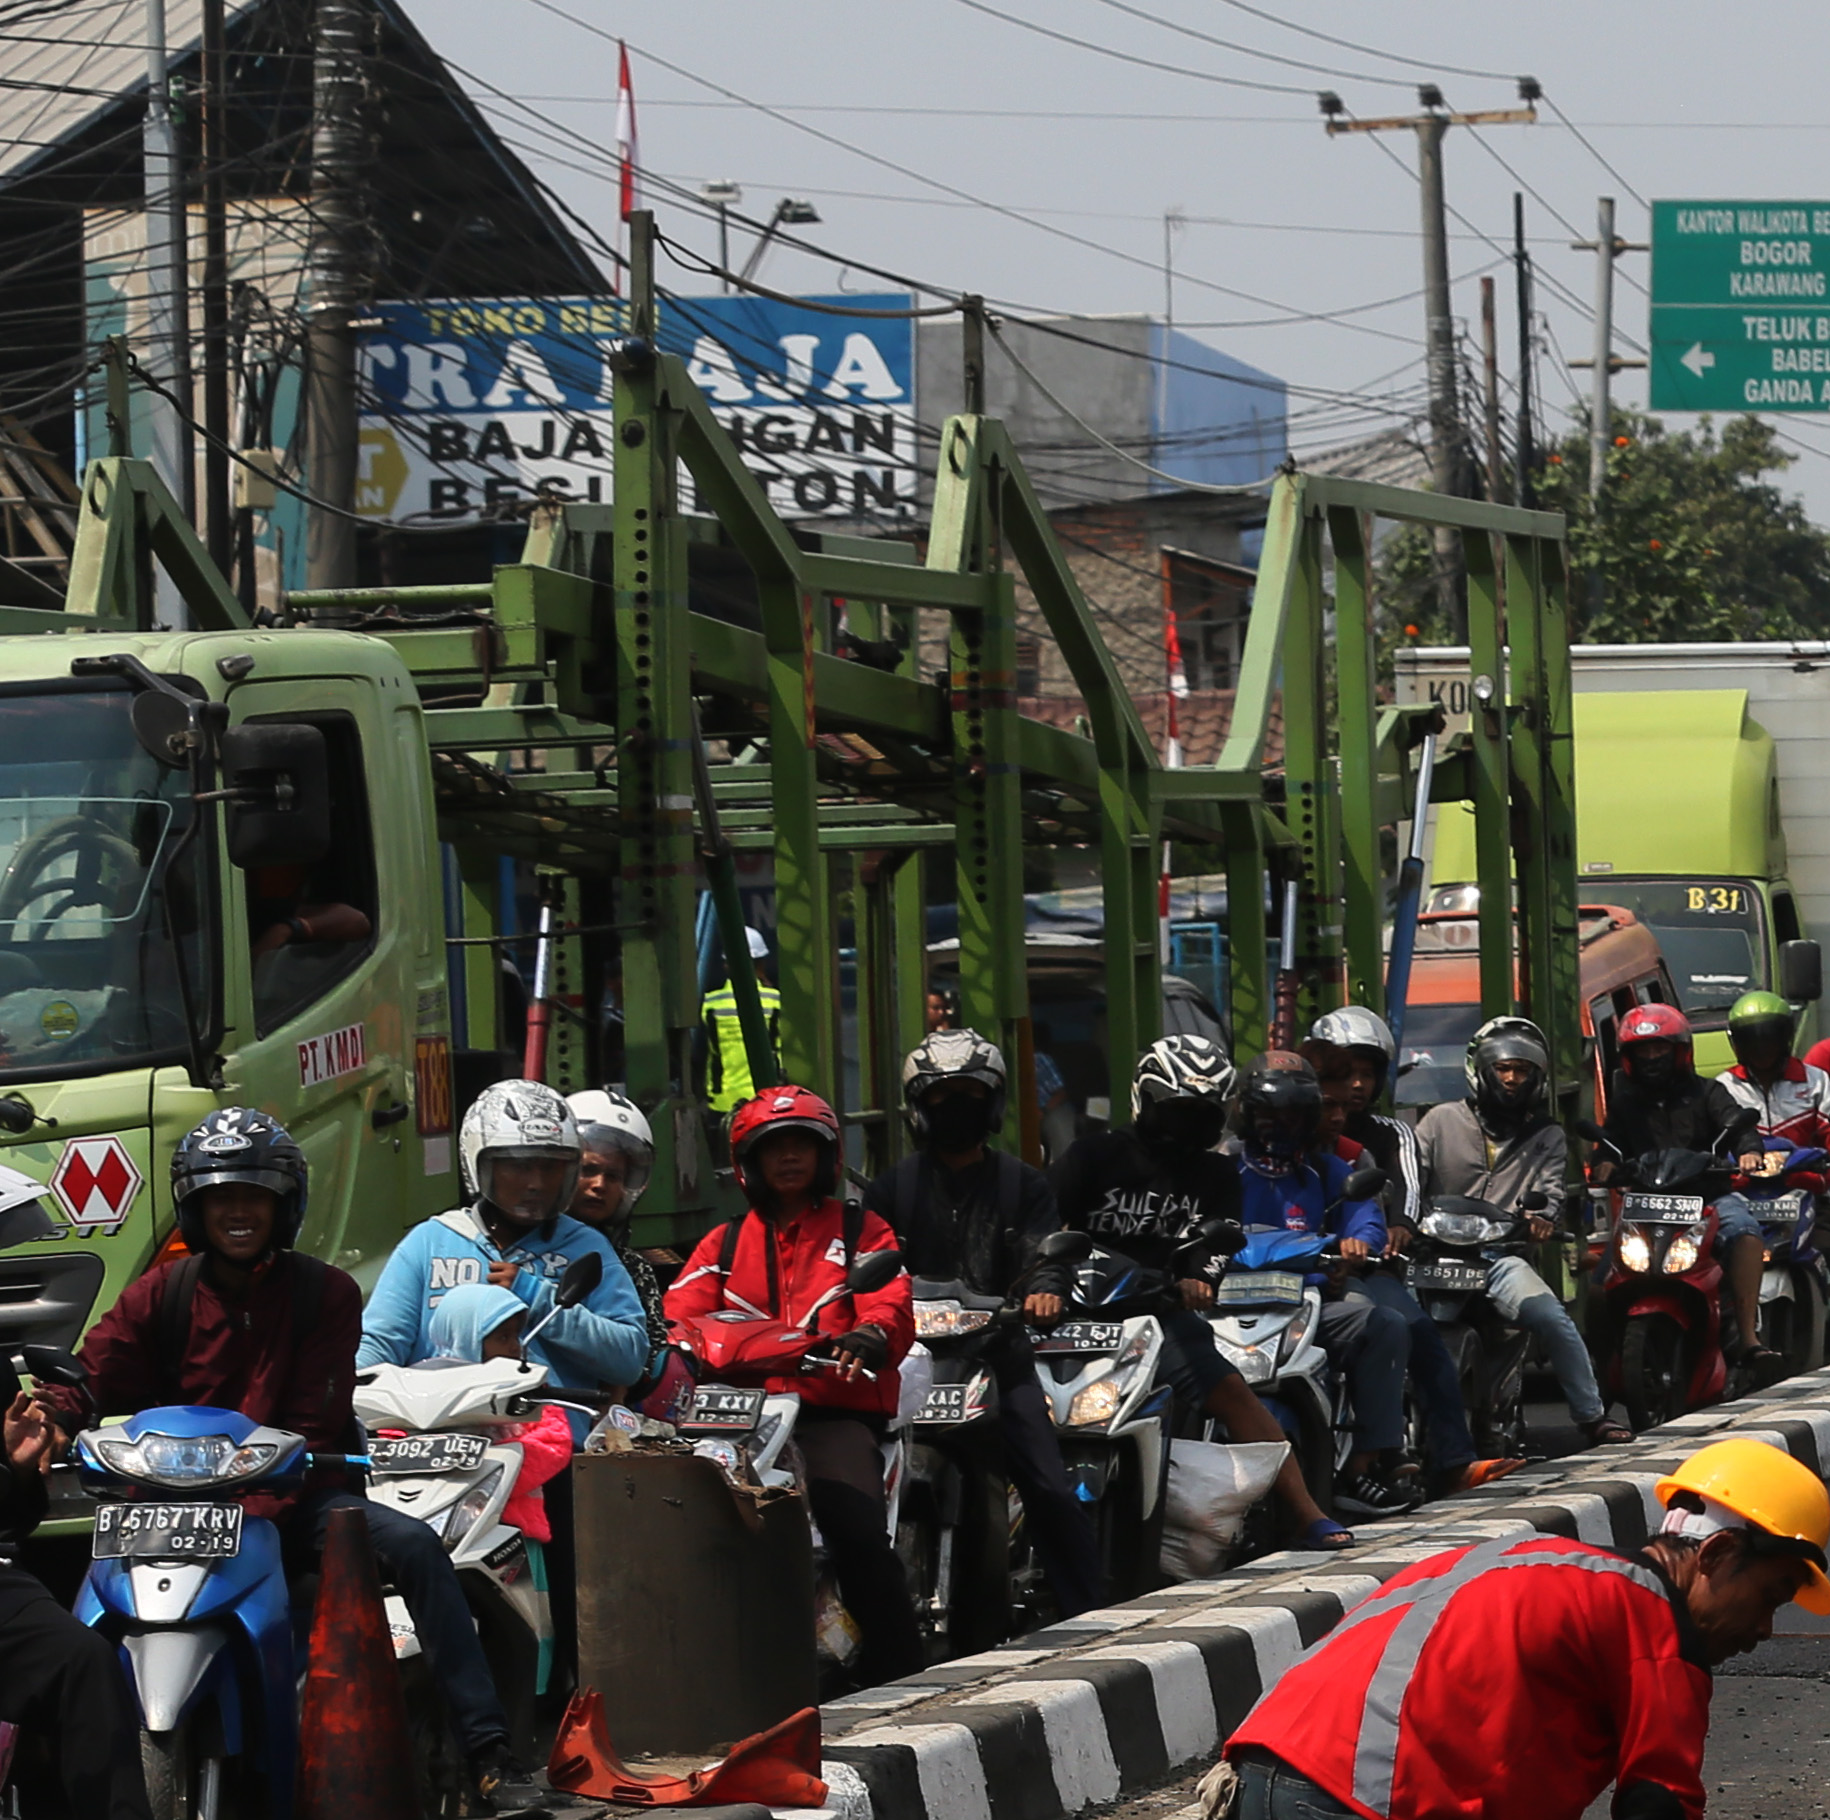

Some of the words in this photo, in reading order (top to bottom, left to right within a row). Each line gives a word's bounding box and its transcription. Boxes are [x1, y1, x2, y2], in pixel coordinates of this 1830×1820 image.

[1677, 210, 1734, 233] KANTOR
[1738, 211, 1808, 234] WALIKOTA
[1740, 241, 1812, 265] BOGOR
[1730, 272, 1826, 296] KARAWANG
[423, 306, 546, 336] TOKO
[1742, 316, 1811, 341] TELUK
[595, 333, 904, 404] AJA
[1744, 379, 1814, 404] GANDA
[429, 420, 603, 461] BAJA
[1688, 887, 1705, 910] B
[1709, 887, 1740, 911] 31
[298, 1040, 323, 1085] PT.
[324, 1024, 367, 1077] KMDI
[1407, 1265, 1415, 1276] B
[99, 1511, 111, 1532] B
[129, 1507, 184, 1530] 6767
[193, 1508, 238, 1529] KRV
[492, 1537, 522, 1563] HONDA
